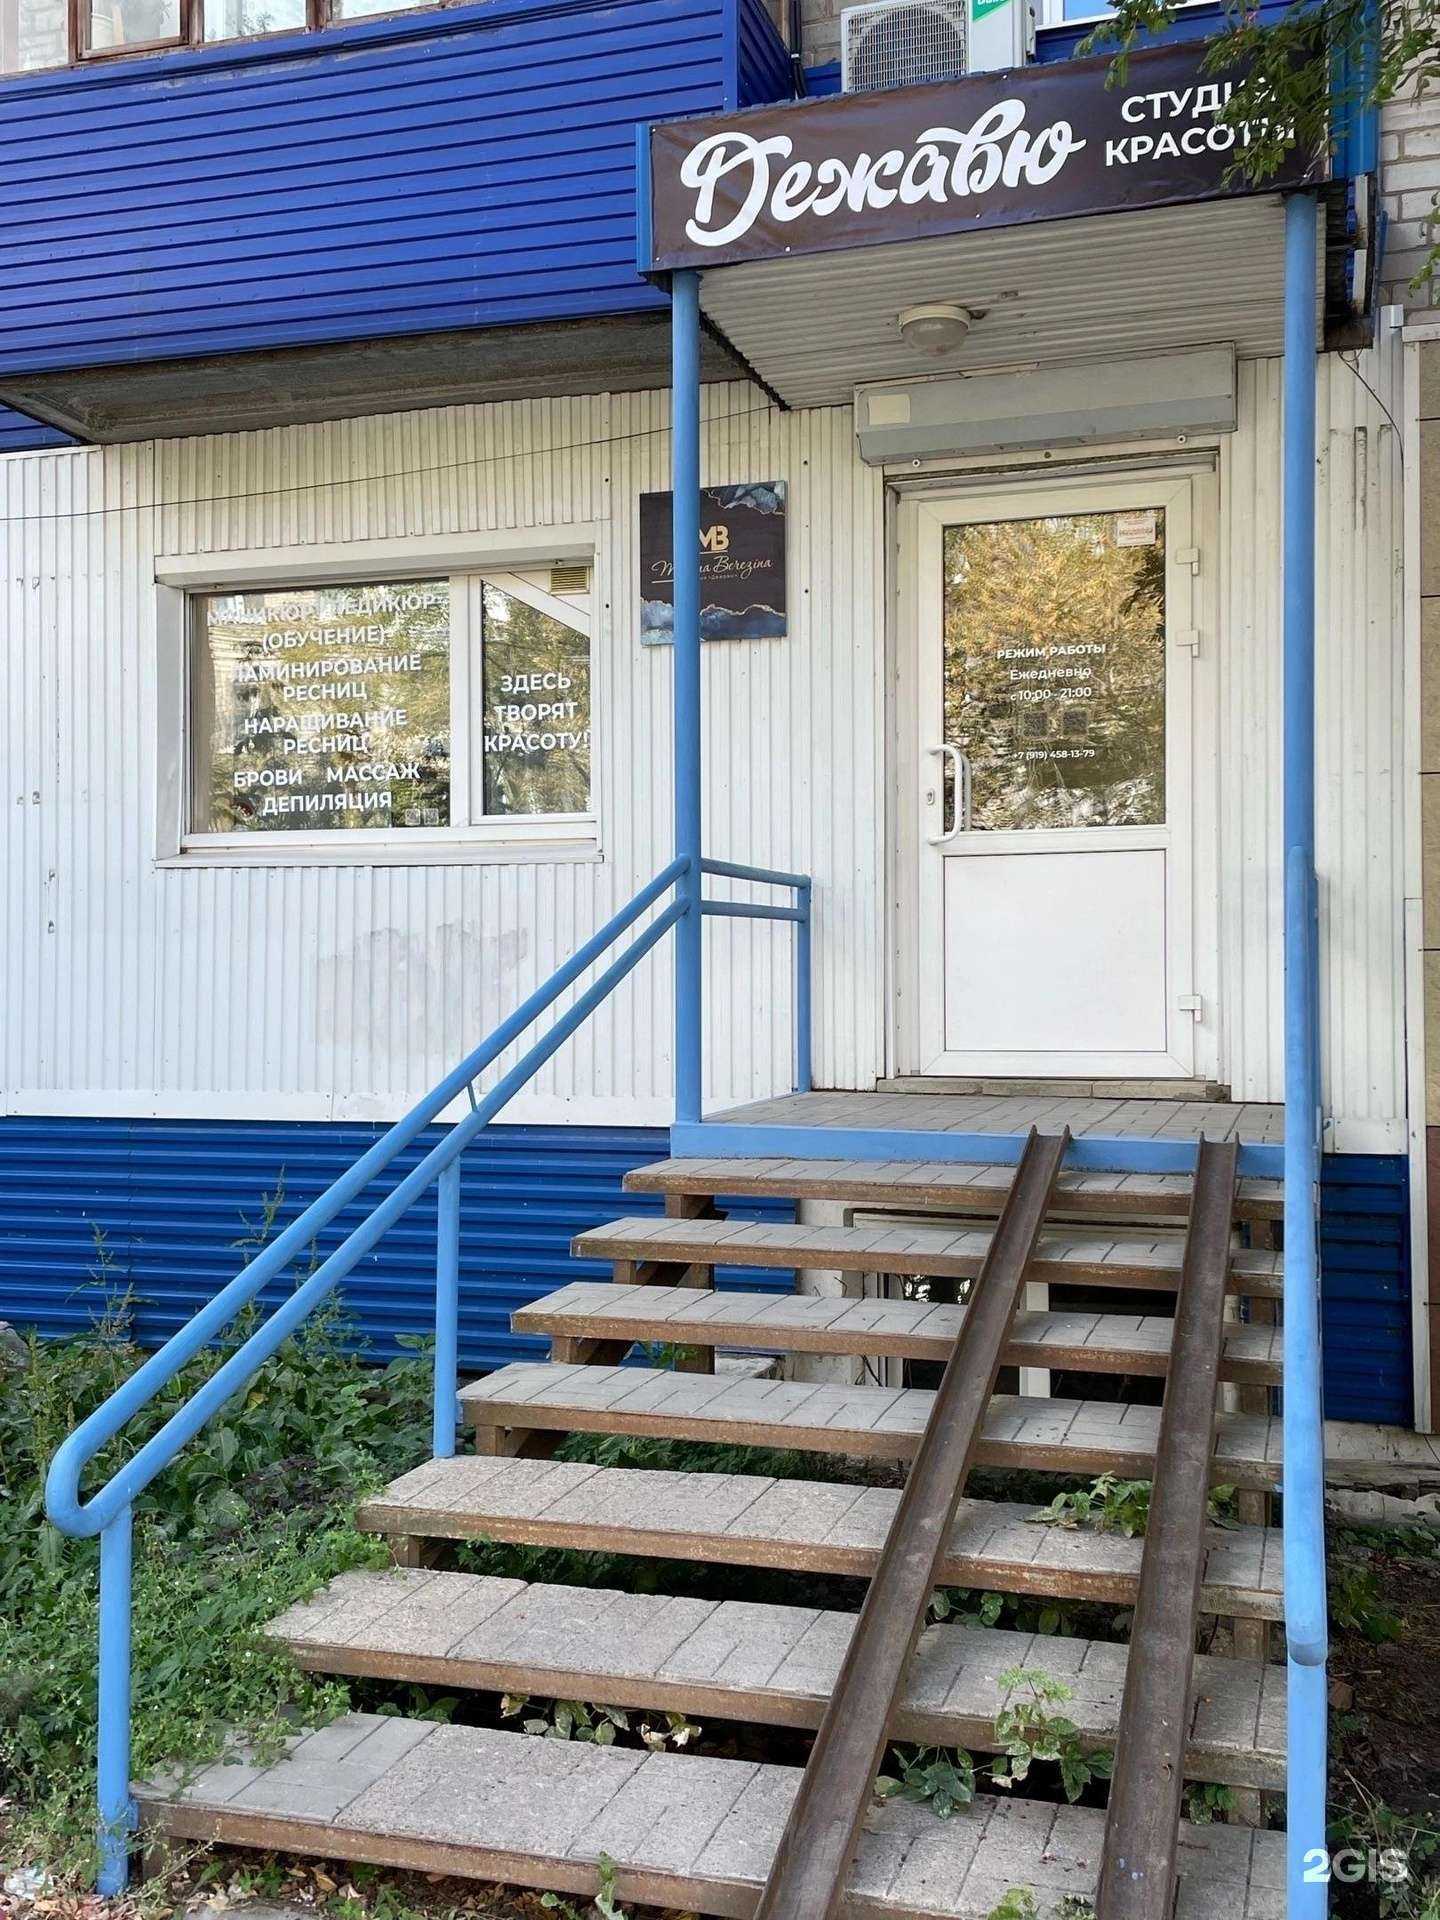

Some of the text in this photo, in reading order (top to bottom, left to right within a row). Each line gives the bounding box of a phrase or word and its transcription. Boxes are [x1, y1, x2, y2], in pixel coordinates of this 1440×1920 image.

[681, 99, 1086, 246] Дежавю
[713, 555, 774, 580] Berezina
[262, 624, 386, 653] (ОБУЧЕНИЕ)
[997, 644, 1106, 660] РЕЖИМ РАБОТЫ
[500, 672, 571, 694] ЗДЕСЬ
[1010, 667, 1092, 681] Ежедневно
[283, 681, 368, 702] РЕСНИЦ
[1018, 689, 1051, 701] 10:00
[1060, 687, 1092, 698] 21:00
[244, 709, 408, 734] НАРАЩИВАНИЕ
[493, 702, 578, 721] ТВОРЯТ
[284, 735, 368, 755] РЕСНИЦ
[484, 731, 588, 752] КРАСОТУ!
[1026, 750, 1048, 760] (919)
[1049, 749, 1095, 759] 458-13-79
[234, 763, 421, 788] БРОВИ МАССАЖ
[262, 791, 392, 816] ДЕПИЛЯЦИЯ
